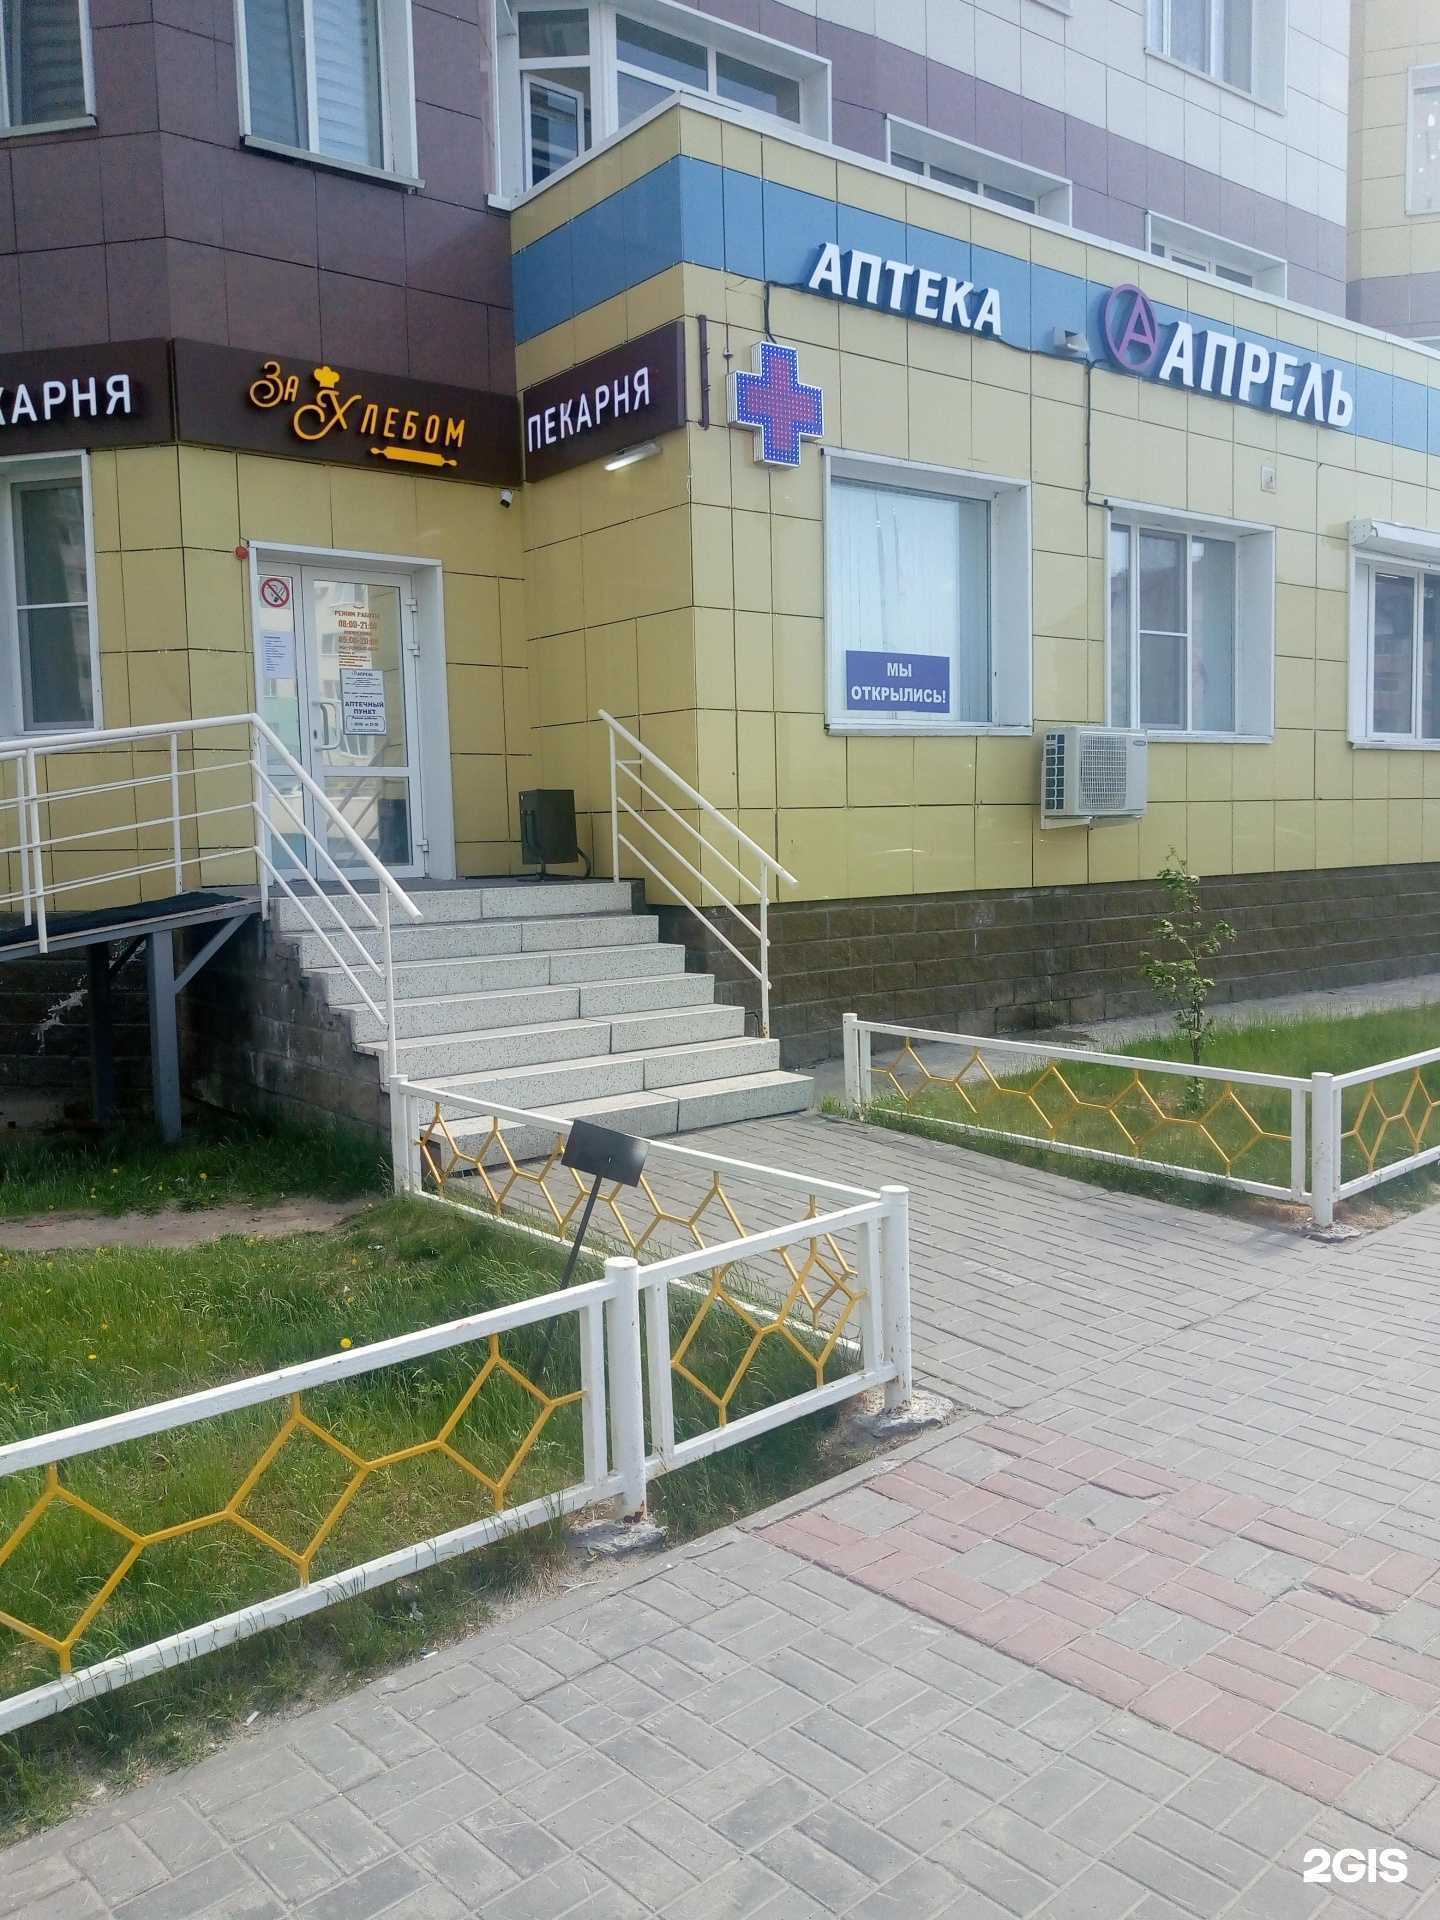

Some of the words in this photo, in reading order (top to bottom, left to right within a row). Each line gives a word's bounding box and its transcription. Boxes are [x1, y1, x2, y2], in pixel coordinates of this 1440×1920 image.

[808, 241, 1002, 336] АПТЕКА
[527, 366, 650, 453] ПЕКАРНЯ
[1159, 321, 1354, 428] АПРЕЛЬ
[851, 686, 946, 703] ОТКРЫЛИСЬ!
[887, 662, 912, 677] МЫ
